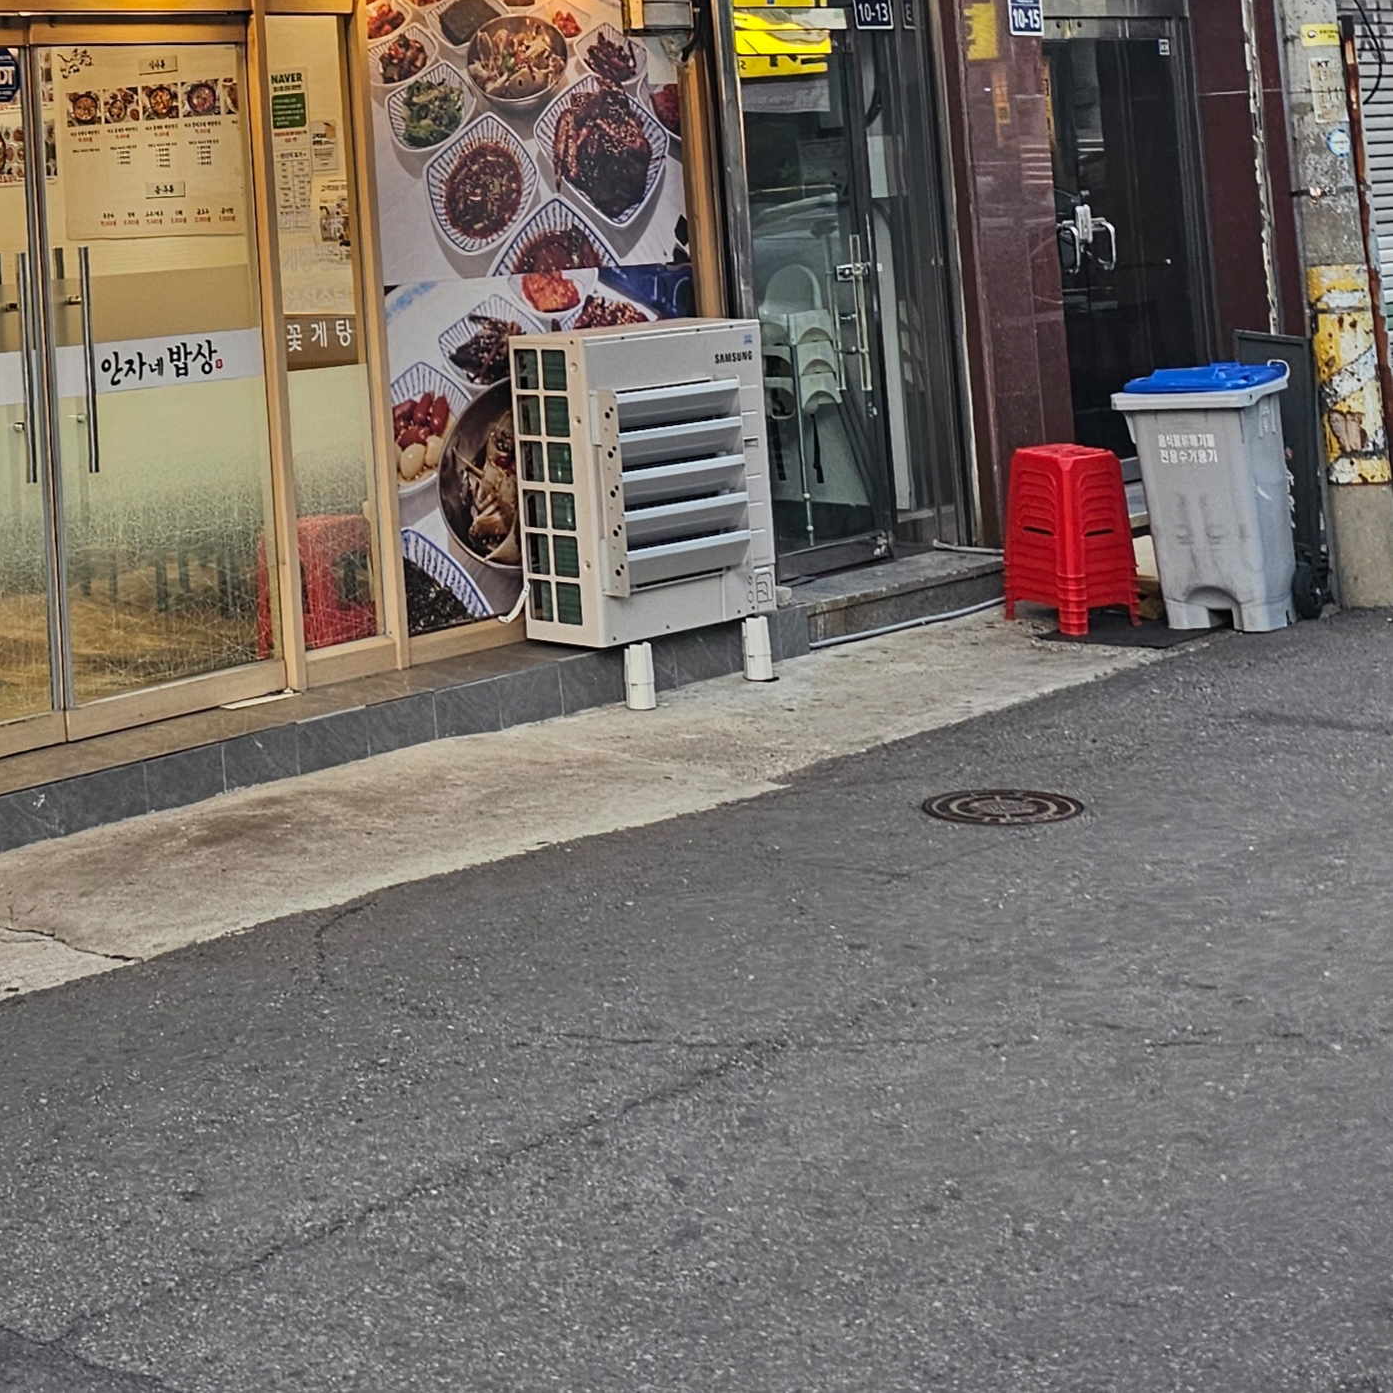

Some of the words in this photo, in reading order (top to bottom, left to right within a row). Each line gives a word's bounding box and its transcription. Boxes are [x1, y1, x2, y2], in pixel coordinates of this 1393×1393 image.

[858, 2, 889, 23] 10-13
[1012, 8, 1041, 29] 10-15
[270, 73, 303, 85] NAVER
[101, 351, 164, 386] 안자네
[167, 339, 218, 377] 밥상
[714, 350, 753, 364] SAMSUNG
